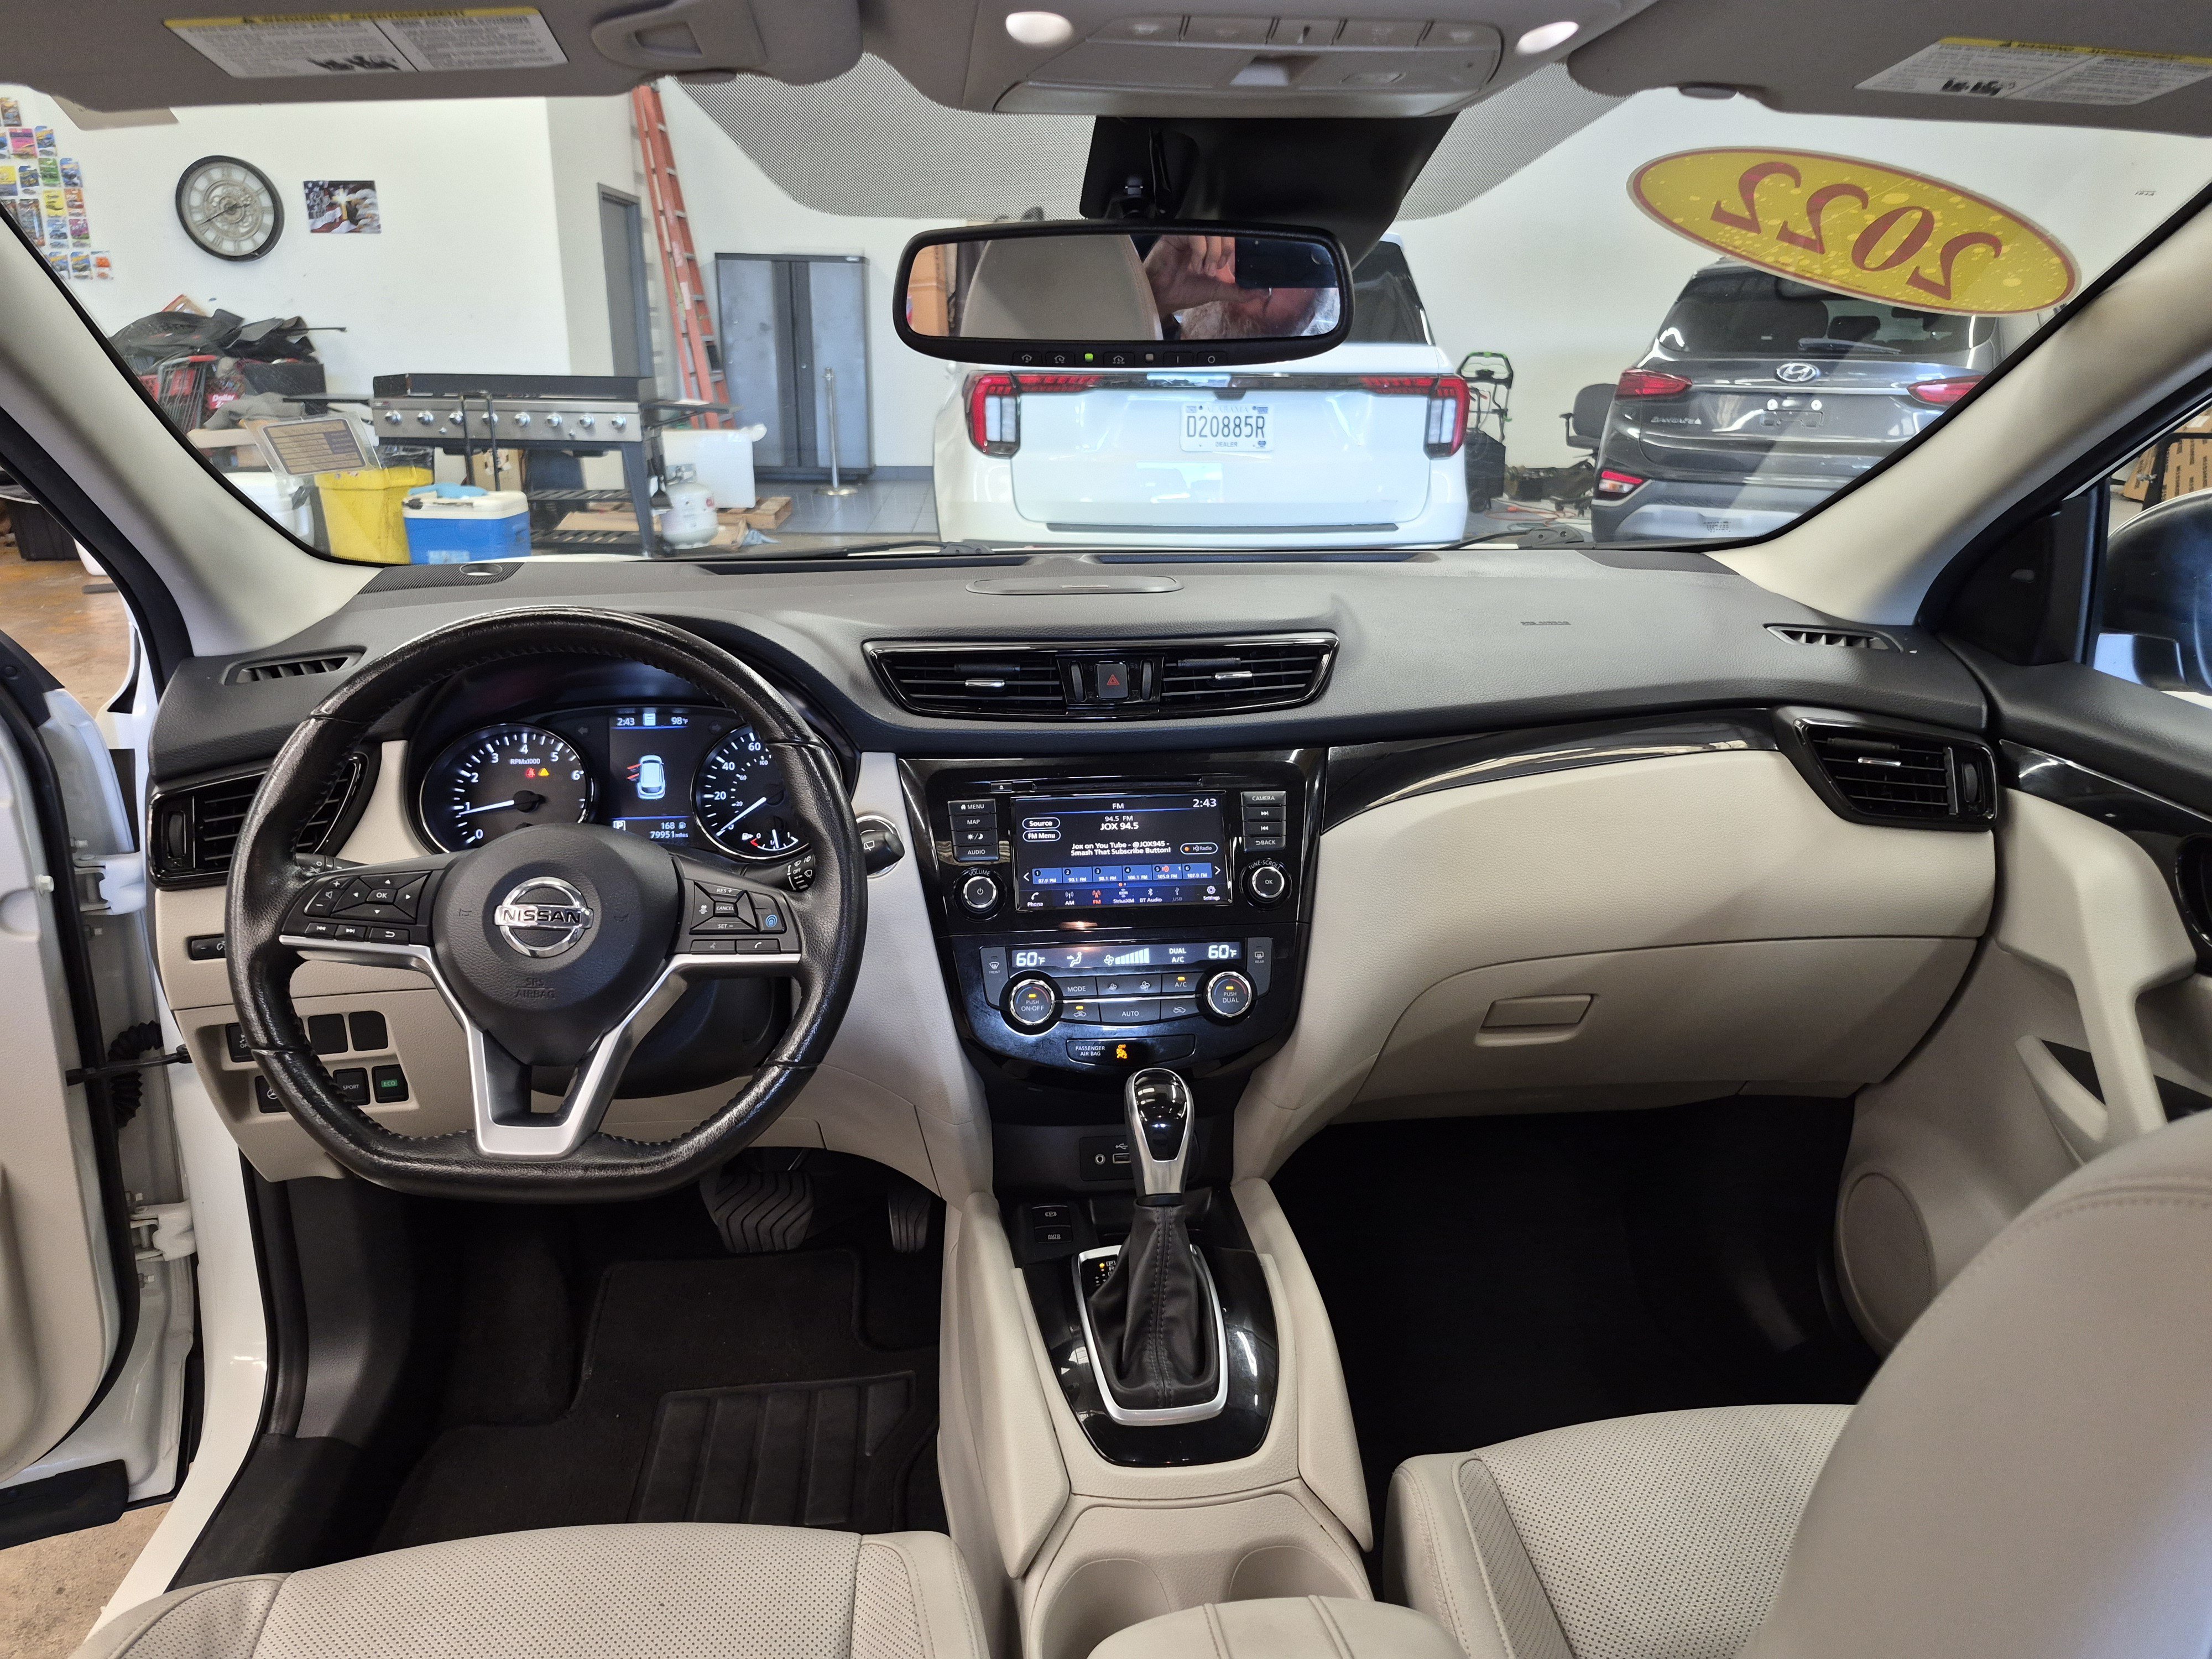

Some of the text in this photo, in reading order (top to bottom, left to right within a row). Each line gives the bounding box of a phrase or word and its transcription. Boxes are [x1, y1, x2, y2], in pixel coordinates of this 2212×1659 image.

[1187, 415, 1265, 438] D20885R
[617, 717, 635, 726] 2:43
[519, 744, 529, 754] 4
[748, 742, 761, 751] 60
[491, 753, 499, 763] 3
[550, 752, 559, 761] 5
[722, 761, 735, 770] 40
[471, 772, 479, 783] 2
[571, 770, 581, 780] 6
[714, 791, 727, 800] 20
[465, 802, 470, 811] 1
[1192, 799, 1217, 807] 2:43
[1100, 822, 1139, 831] JOX 94.5
[475, 828, 483, 839] 0
[649, 831, 674, 839] 79951
[503, 909, 581, 924] NISSAN
